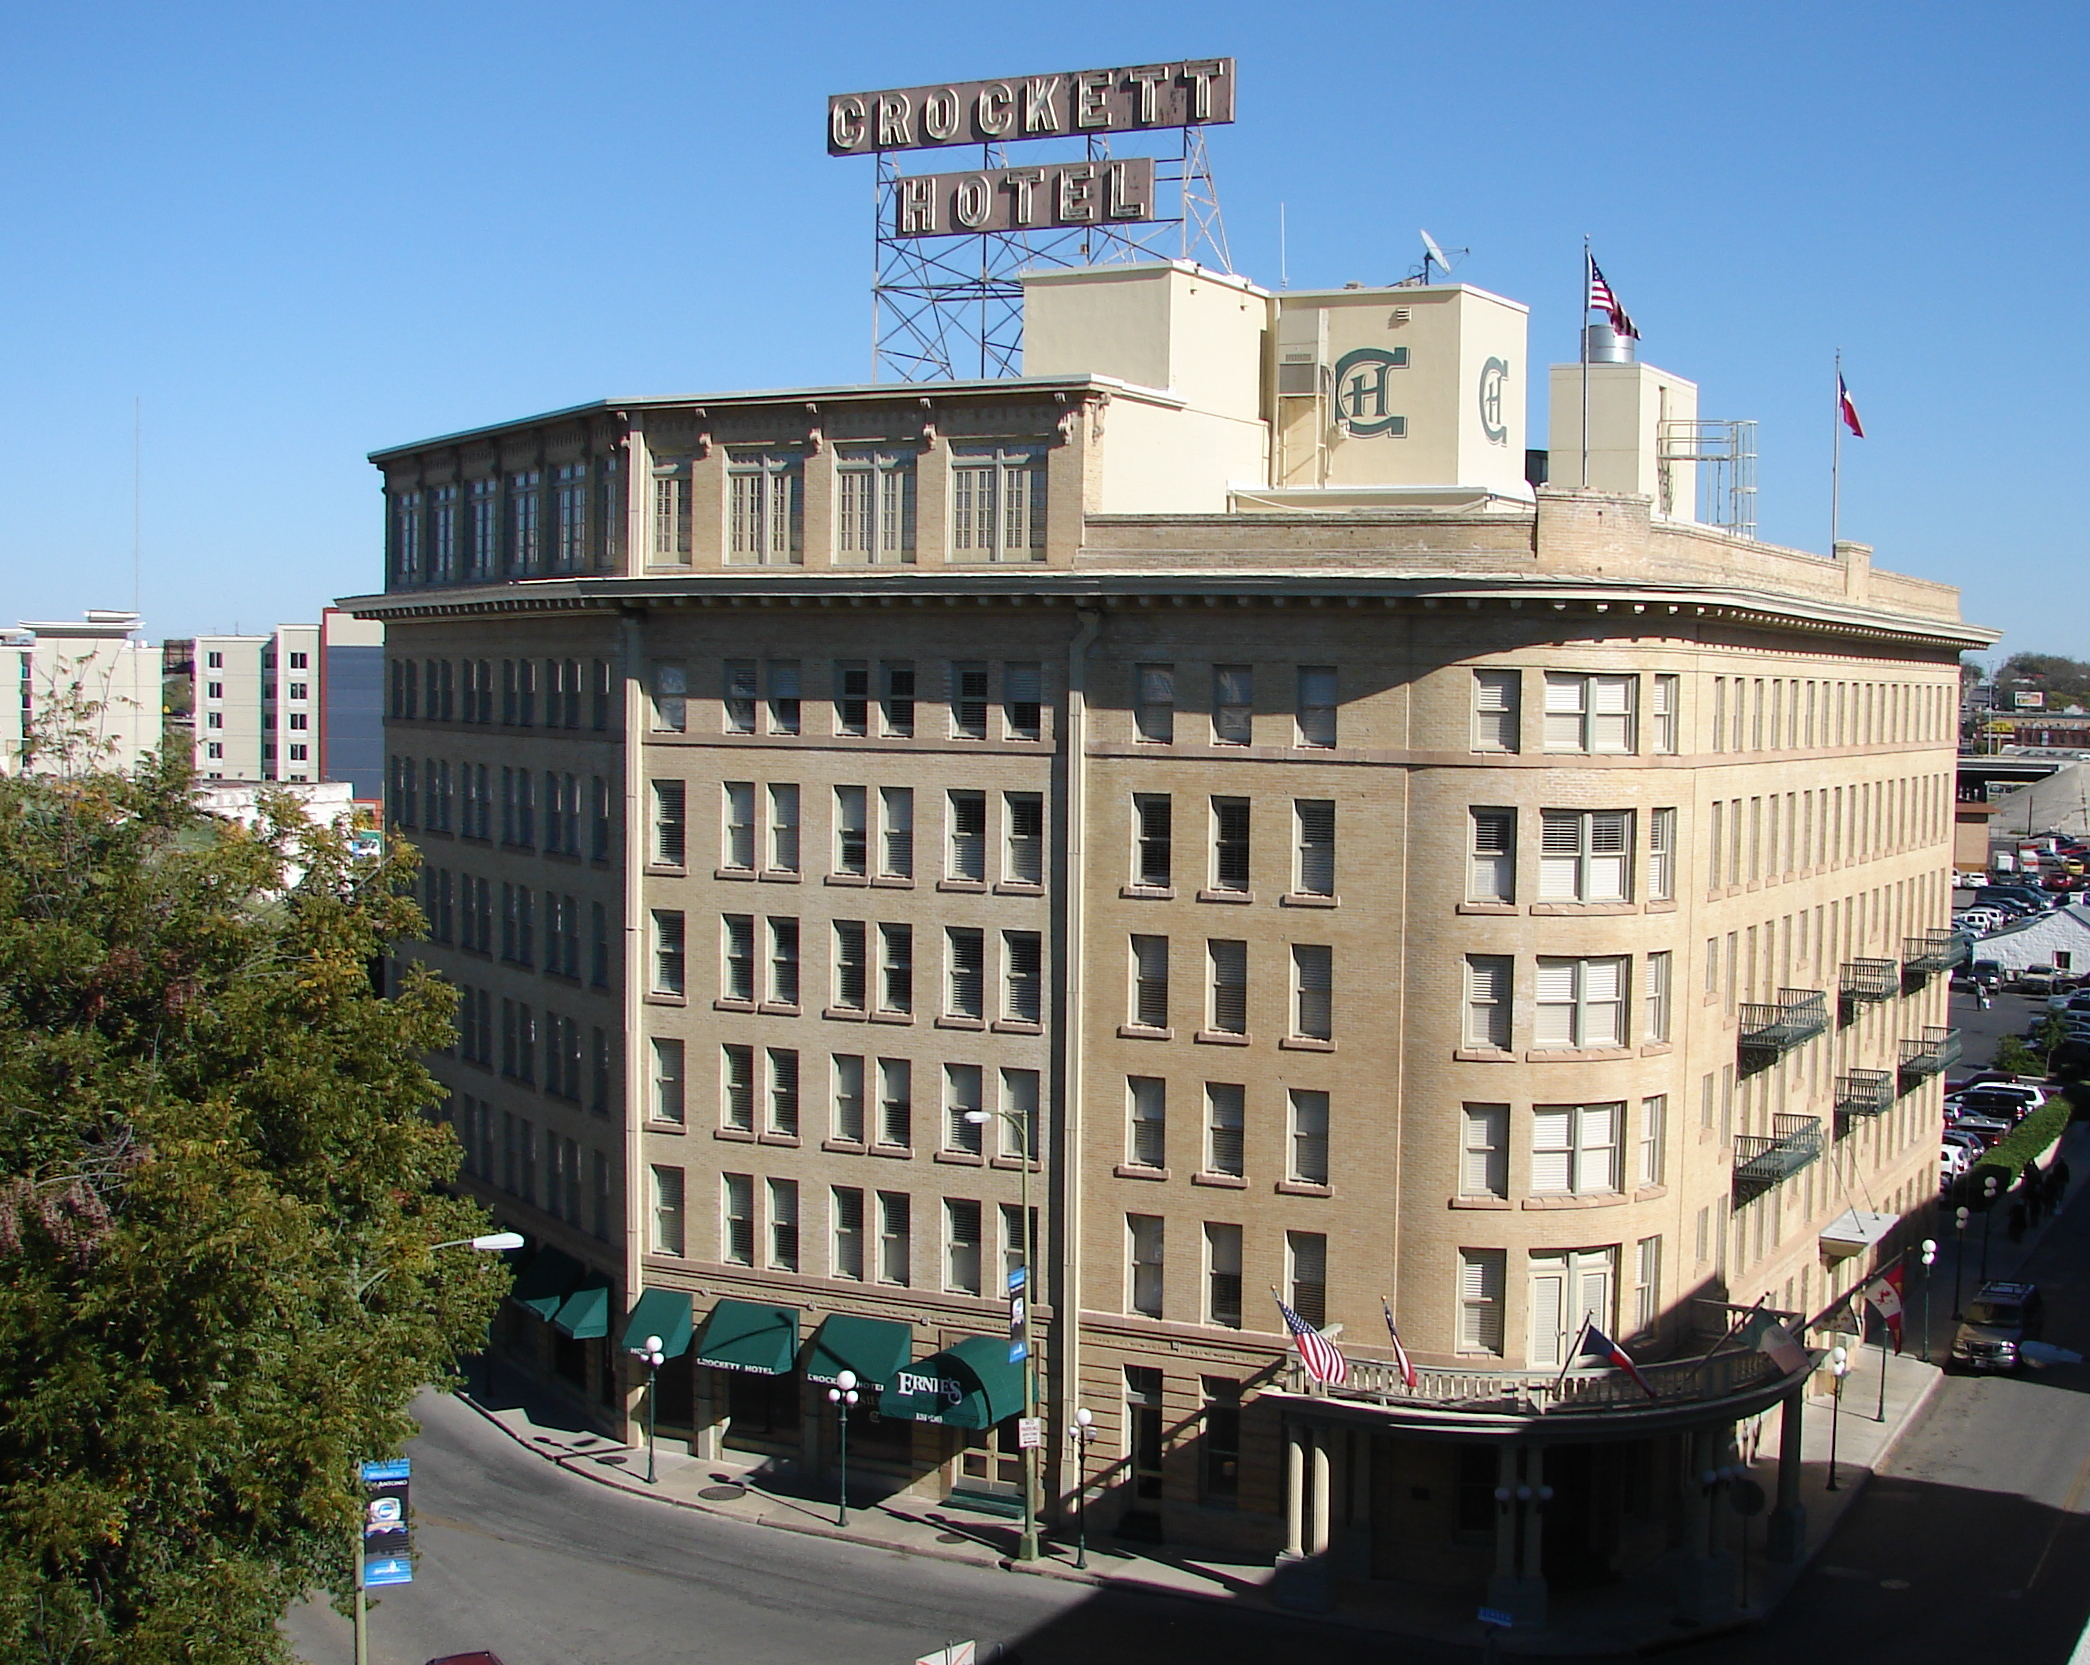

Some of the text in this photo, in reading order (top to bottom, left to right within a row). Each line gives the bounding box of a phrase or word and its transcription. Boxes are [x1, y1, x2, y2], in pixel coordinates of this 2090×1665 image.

[832, 61, 1225, 149] CROCKETT
[902, 162, 1145, 234] HOTEL
[696, 1357, 775, 1375] CROCKETT HOTEL
[898, 1371, 962, 1405] ERNIE'S
